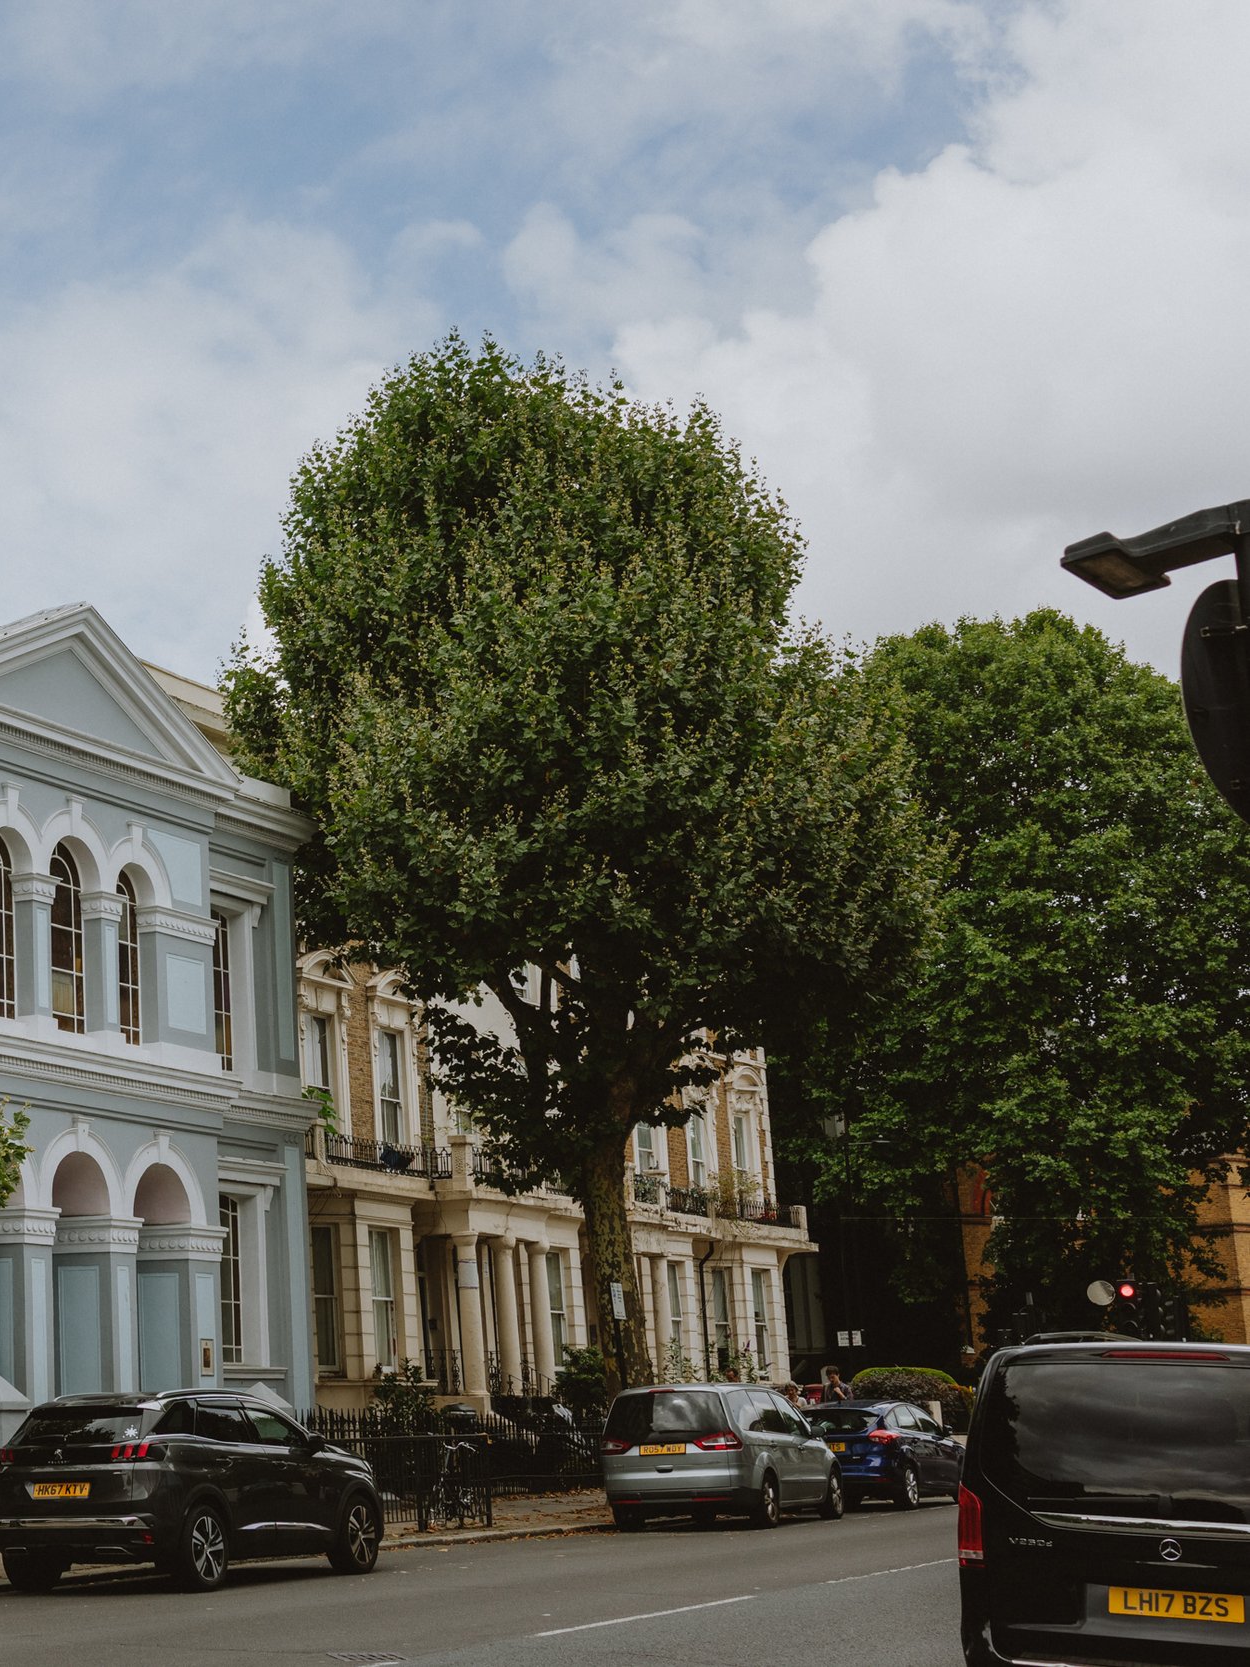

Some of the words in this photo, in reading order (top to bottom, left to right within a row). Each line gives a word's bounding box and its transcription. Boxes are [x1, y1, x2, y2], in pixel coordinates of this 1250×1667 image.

[37, 1484, 64, 1495] HK67
[65, 1483, 85, 1495] KTV
[1123, 1590, 1175, 1613] LH17
[1182, 1595, 1229, 1617] BZS
